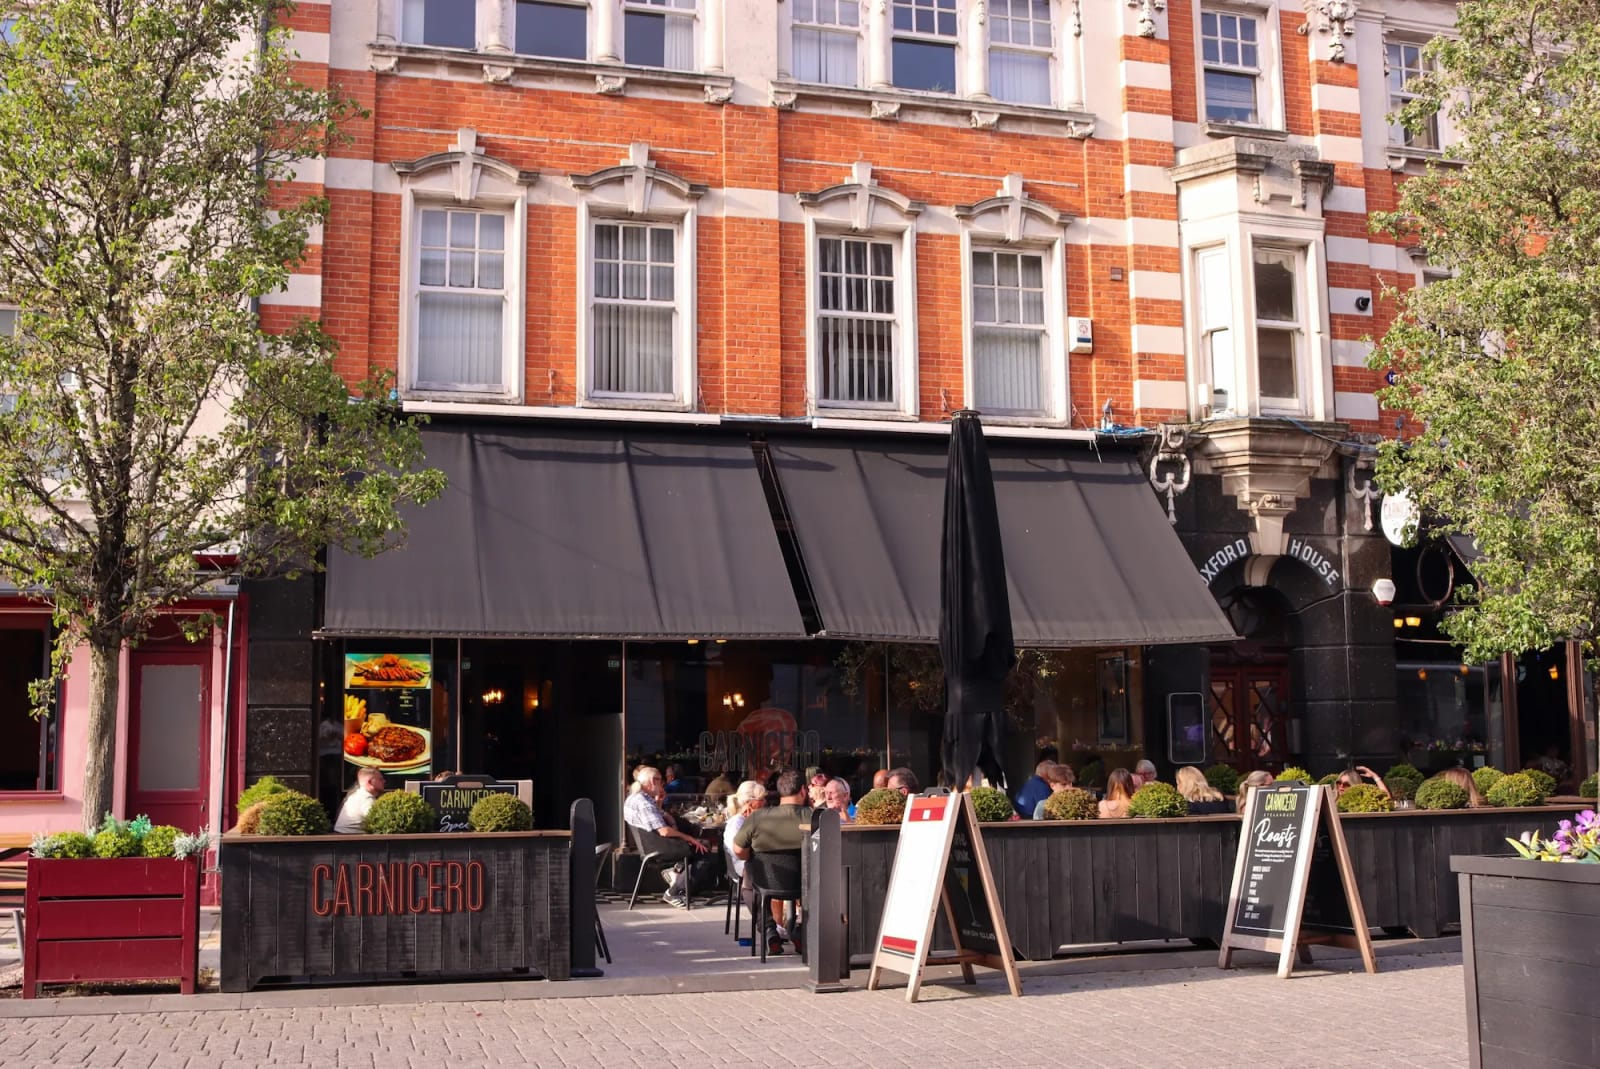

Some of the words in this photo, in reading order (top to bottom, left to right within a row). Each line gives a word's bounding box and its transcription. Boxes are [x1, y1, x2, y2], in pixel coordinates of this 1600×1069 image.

[1290, 539, 1340, 585] HOUSE
[699, 730, 820, 772] CARNICERO
[440, 789, 497, 809] CARNICE
[1265, 793, 1298, 811] CARNICERO
[1254, 817, 1297, 848] Roasts
[312, 861, 484, 916] CARNICERO
